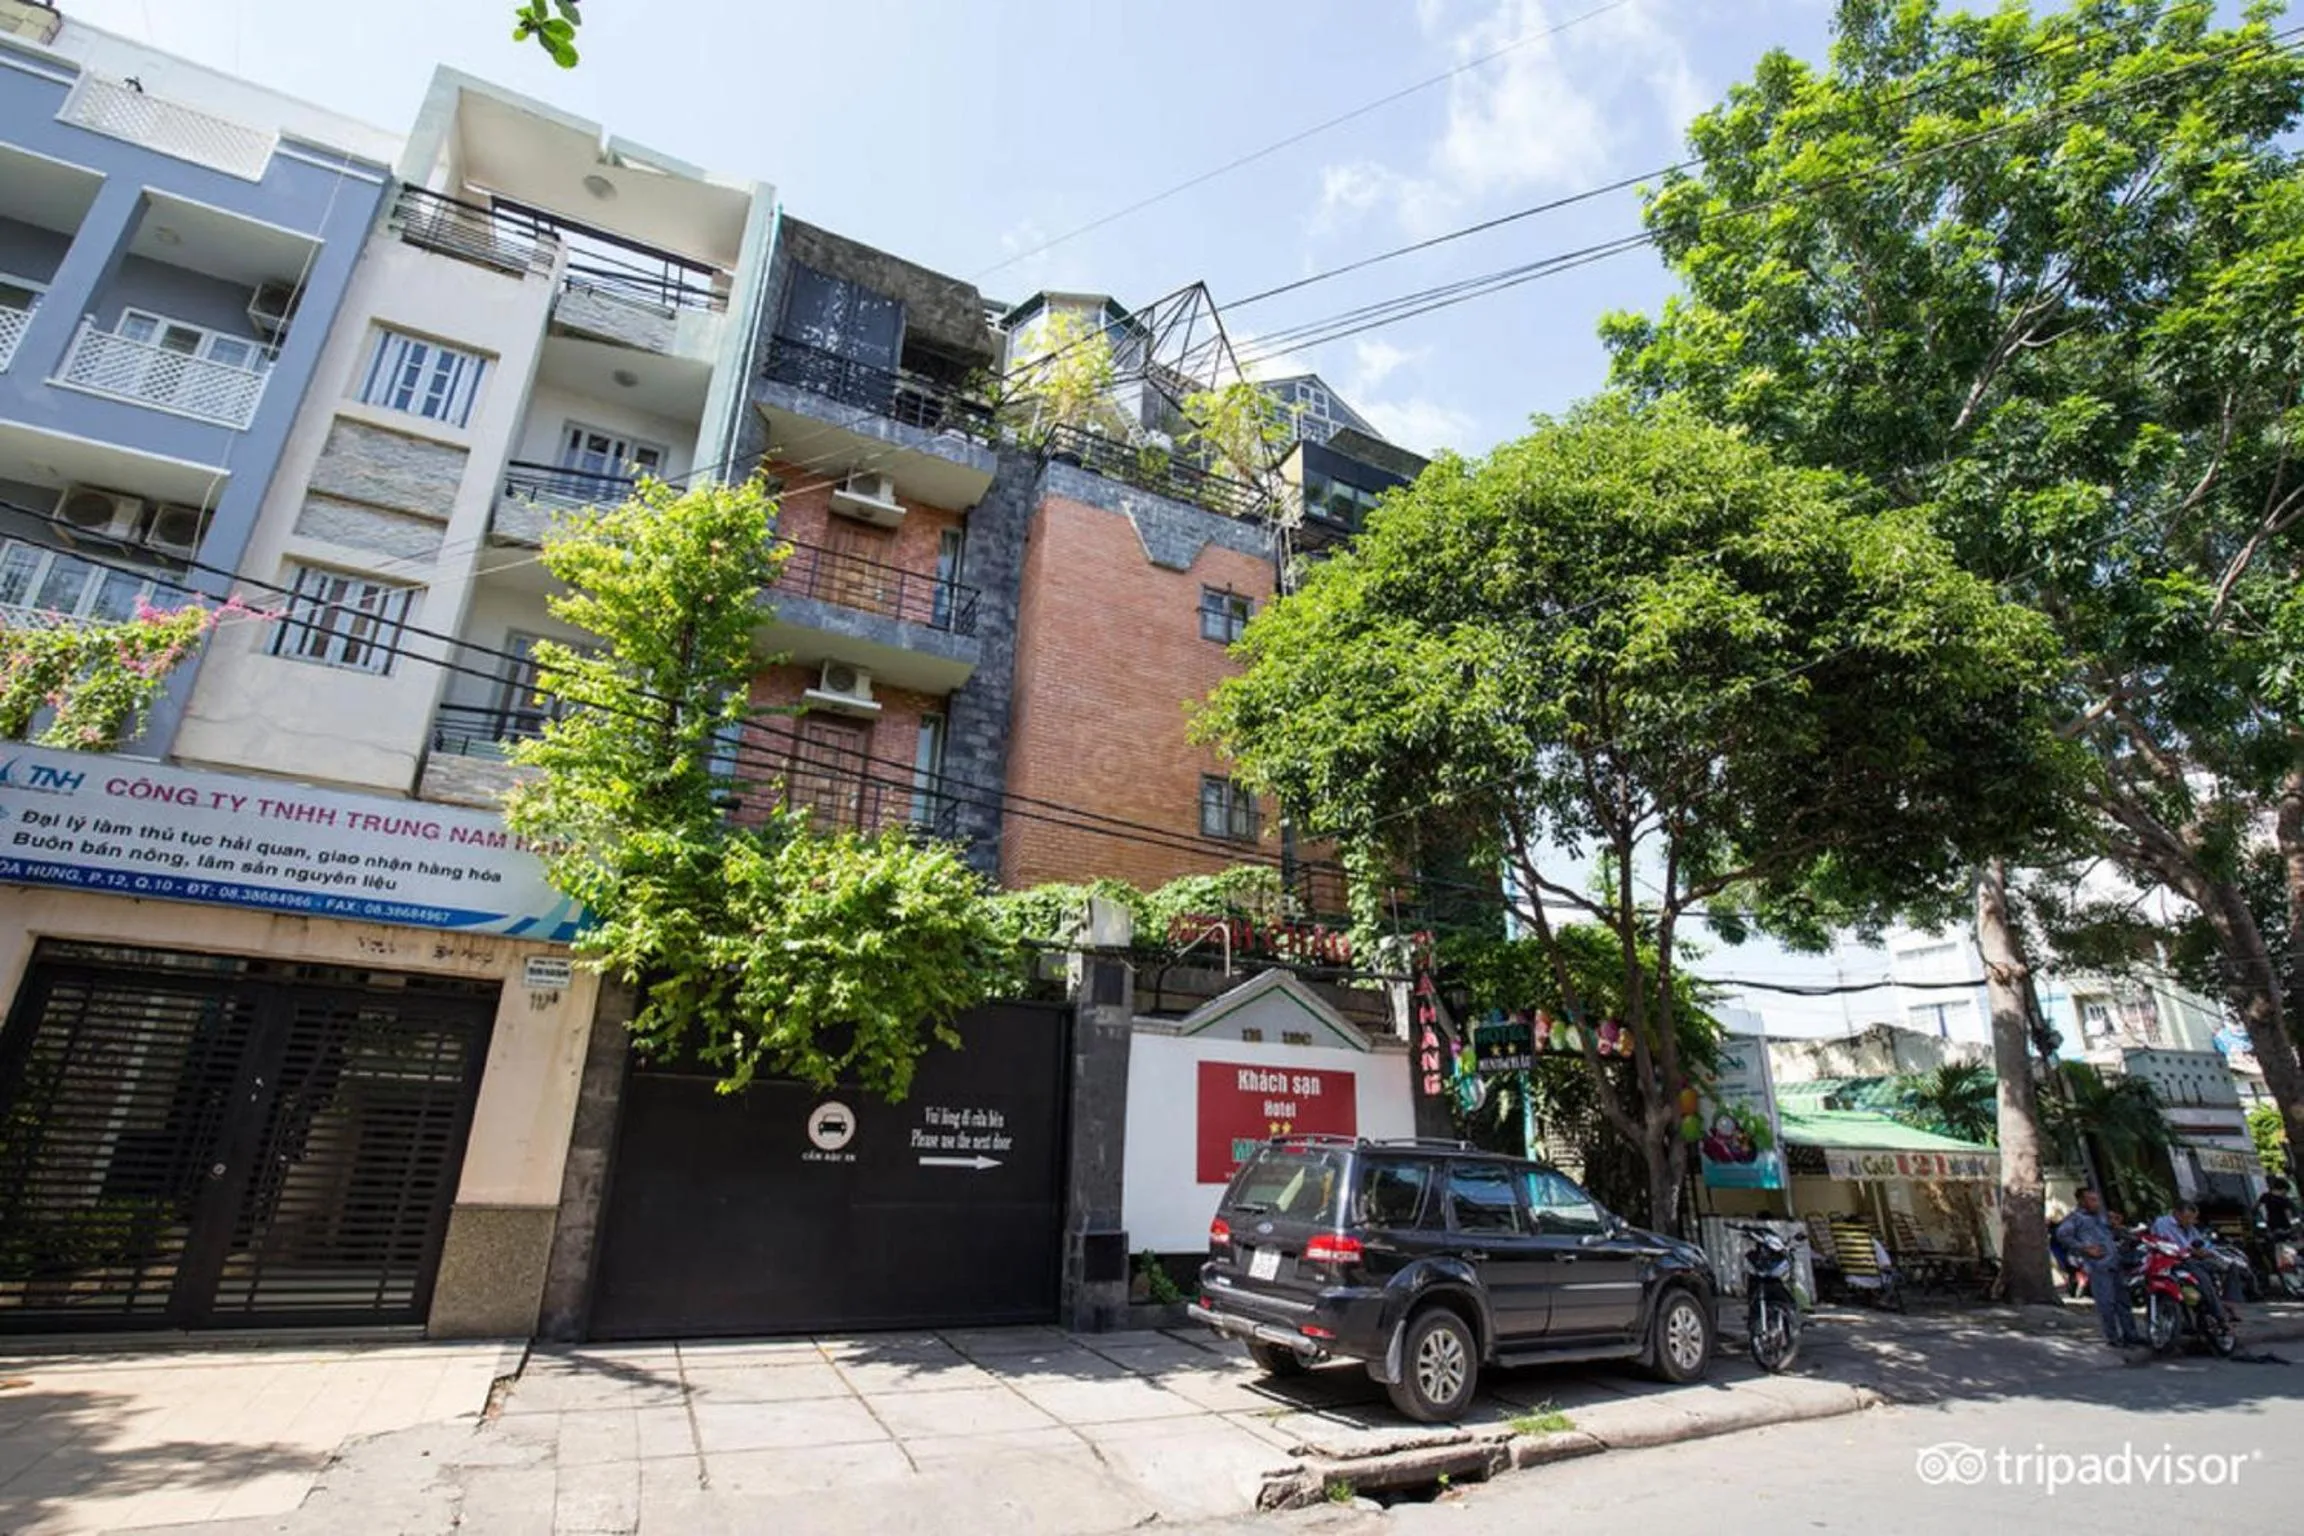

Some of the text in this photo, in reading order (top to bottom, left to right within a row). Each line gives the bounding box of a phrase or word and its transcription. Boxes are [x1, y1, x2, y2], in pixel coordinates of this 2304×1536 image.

[28, 764, 87, 790] TNH
[105, 777, 200, 806] CÔNG
[210, 791, 248, 813] TY
[257, 799, 337, 827] TNHH
[347, 811, 442, 840] TRUNG
[449, 826, 508, 849] NAM
[22, 808, 60, 828] Đại
[66, 815, 87, 833] lý
[93, 818, 132, 837] làm
[140, 825, 175, 842] thủ
[181, 830, 213, 847] tục
[219, 834, 252, 851] hải
[256, 841, 311, 861] quan,
[318, 849, 360, 865] giao
[364, 855, 411, 873] nhận
[417, 861, 463, 881] hàng
[13, 831, 397, 890] Buôn bán nông, lâm sản nguyên liệu
[1238, 1068, 1321, 1099] Khách sạn
[1264, 1100, 1296, 1117] Hotel
[911, 1128, 938, 1148] Please
